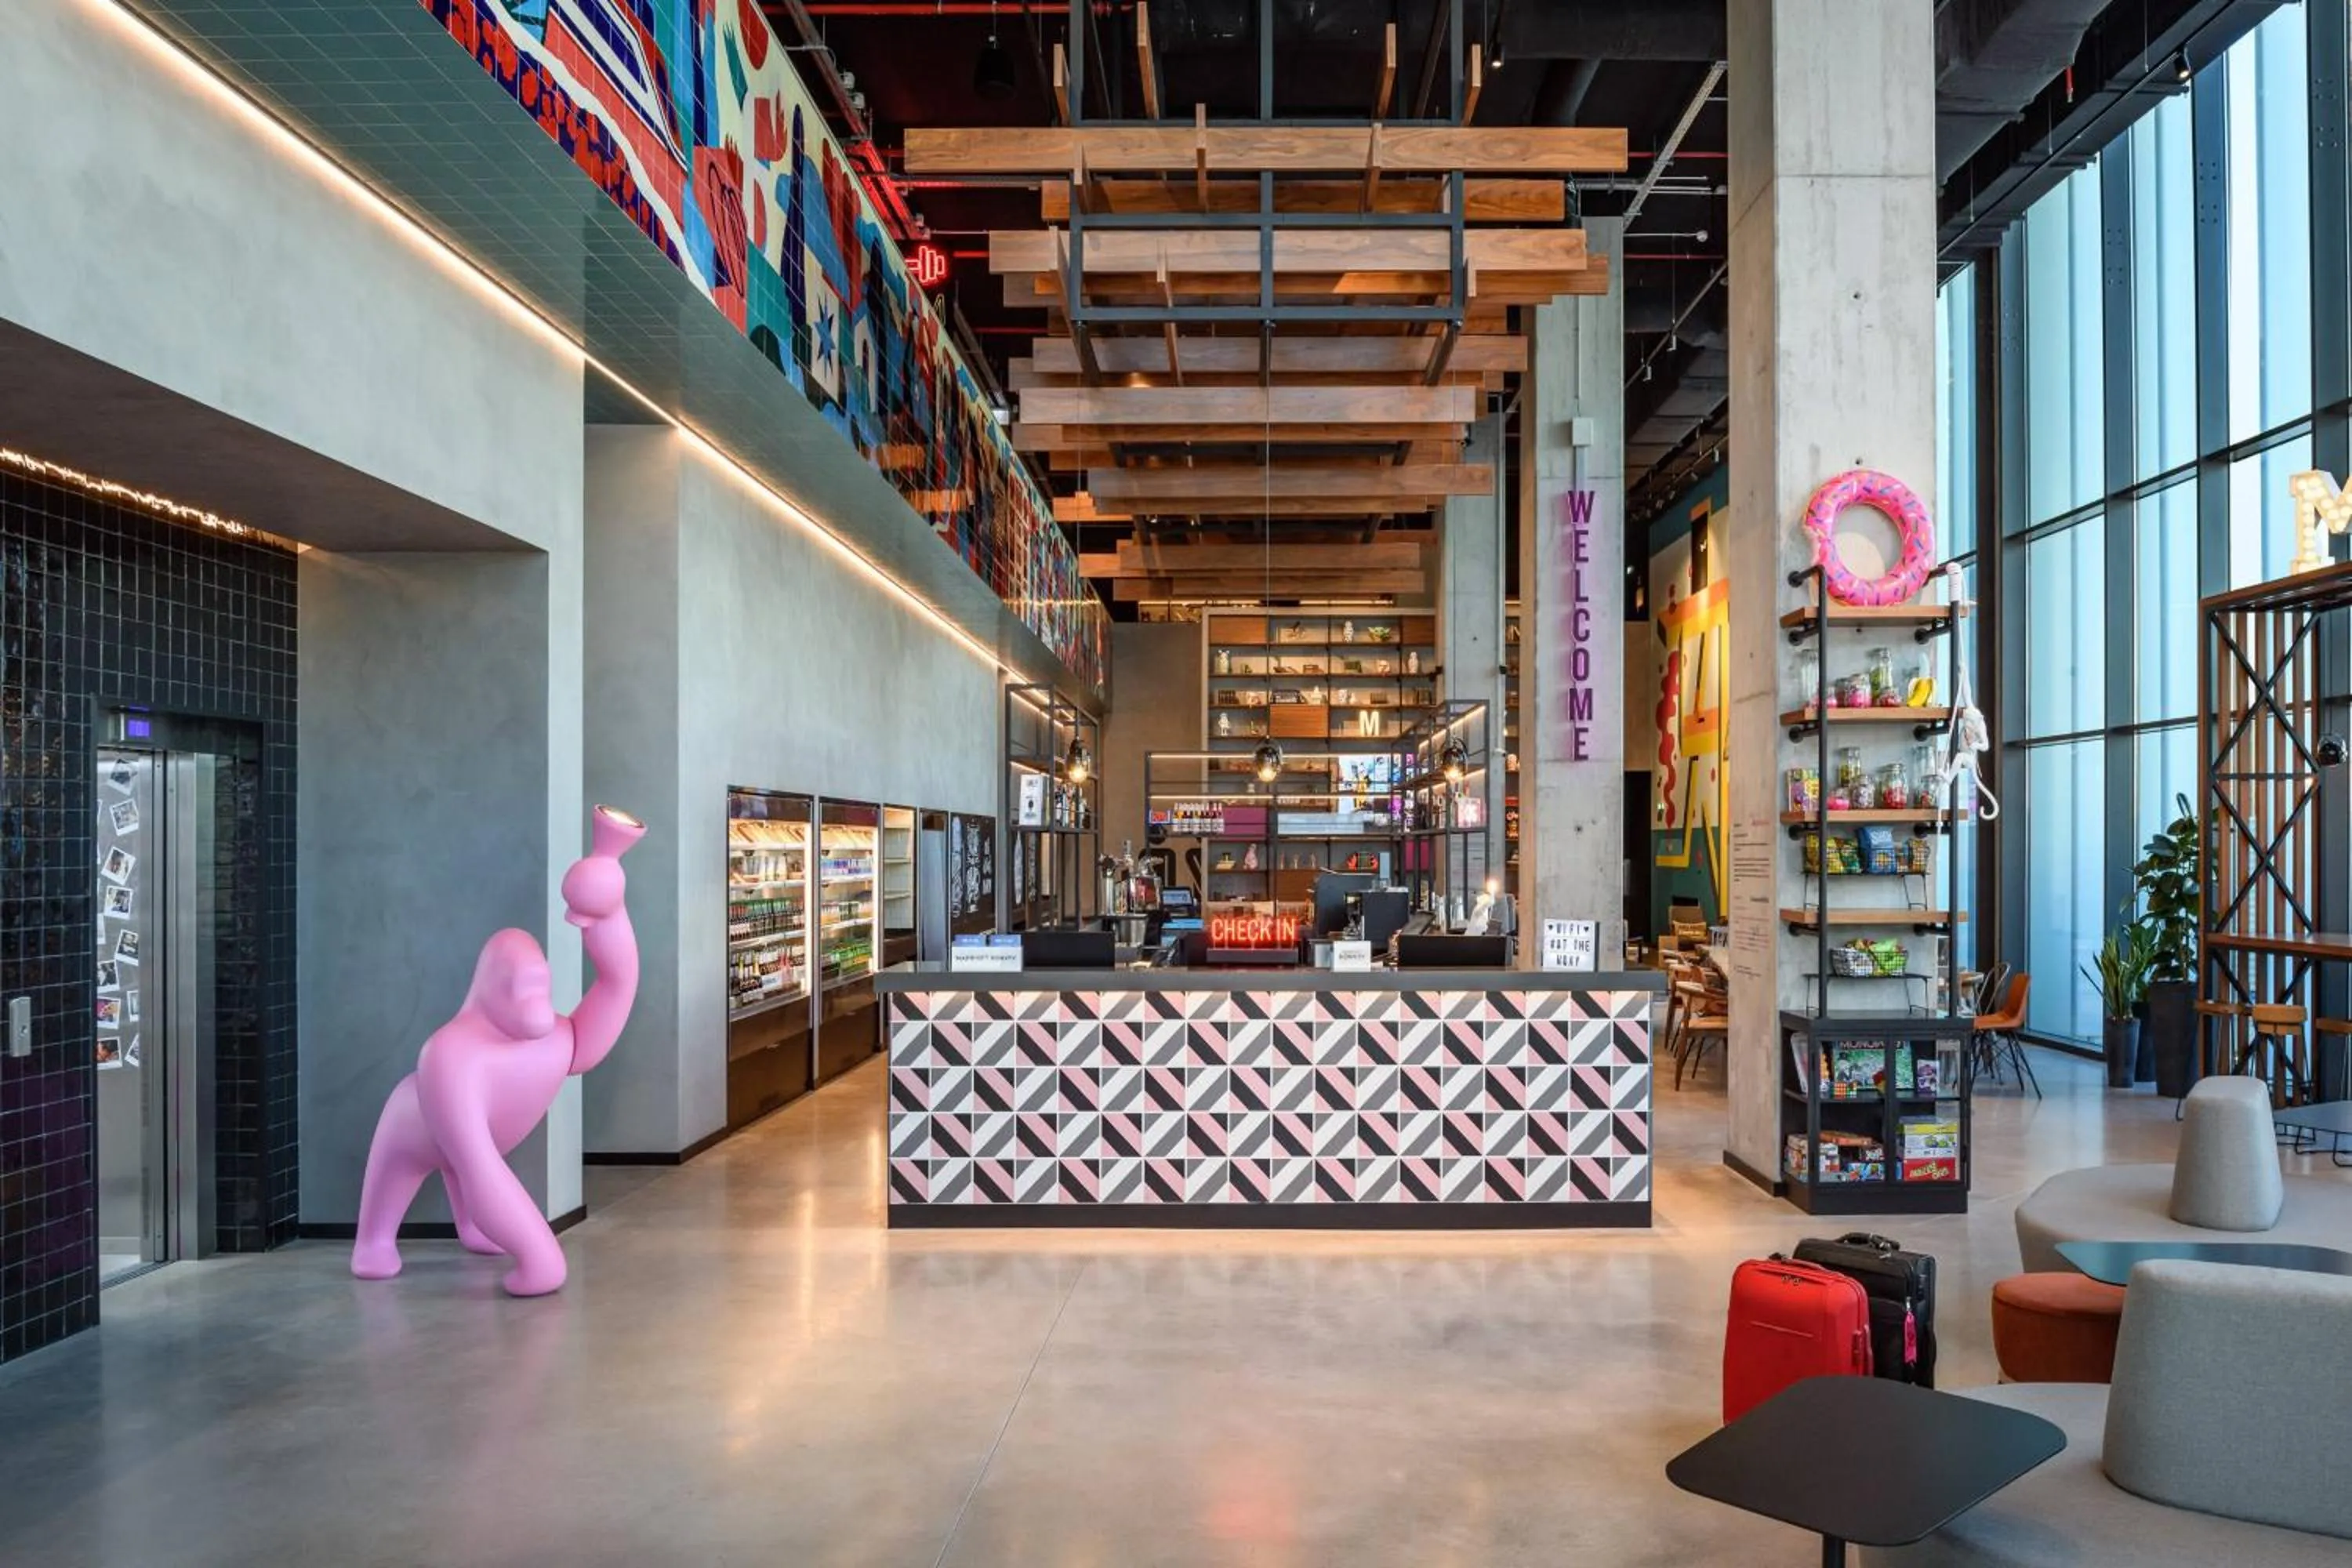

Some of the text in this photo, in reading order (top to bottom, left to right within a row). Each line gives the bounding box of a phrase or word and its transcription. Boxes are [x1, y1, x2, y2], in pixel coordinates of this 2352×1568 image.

[2290, 469, 2352, 575] M
[1567, 490, 1595, 762] WELCOME
[1359, 709, 1380, 737] M
[1211, 918, 1296, 942] CHECK IN
[1573, 939, 1590, 952] THE
